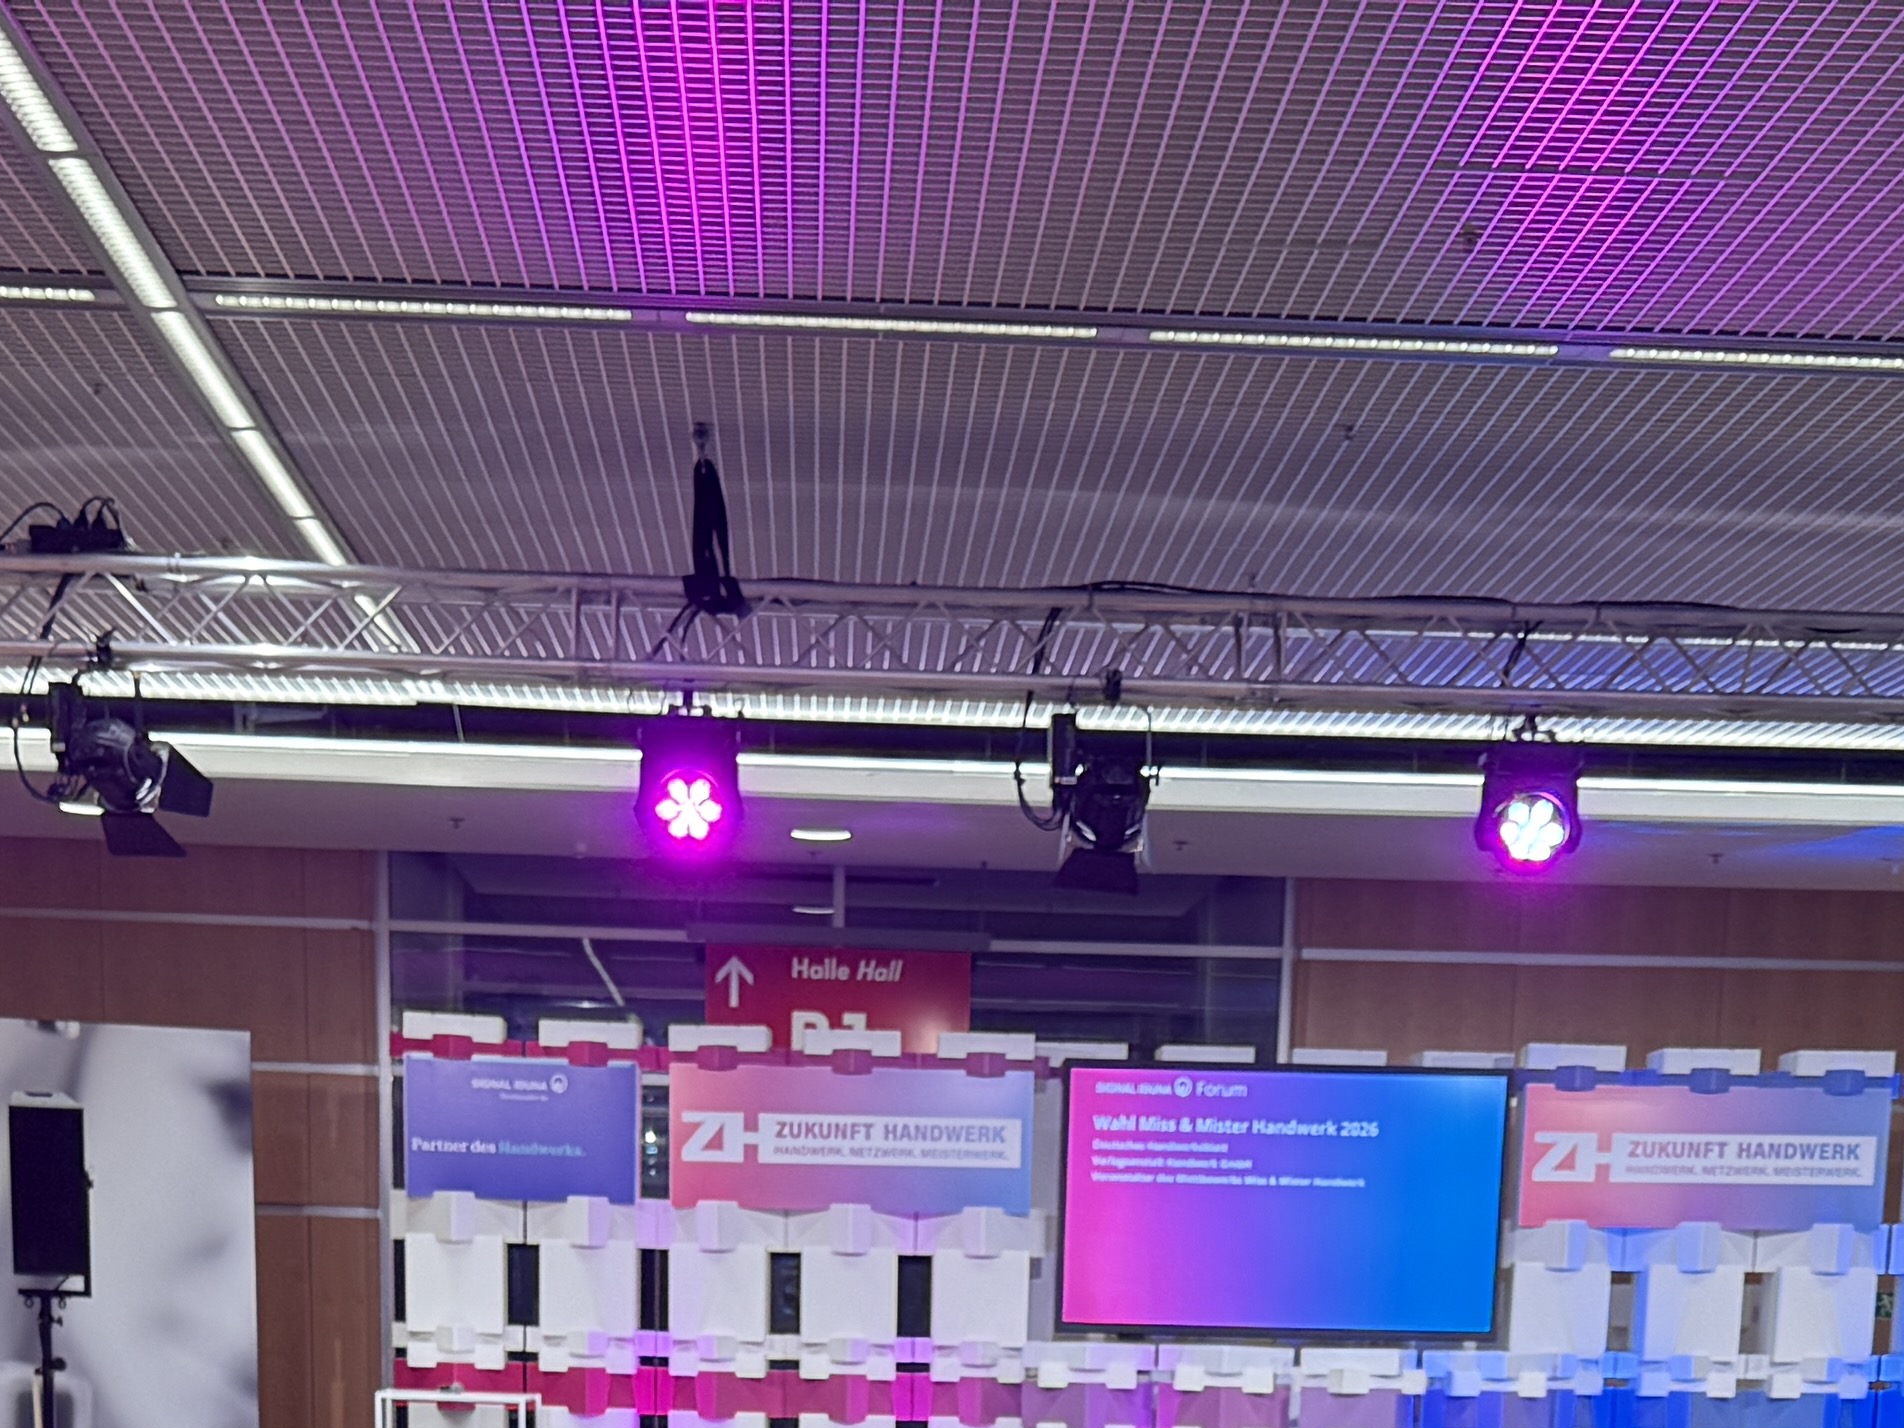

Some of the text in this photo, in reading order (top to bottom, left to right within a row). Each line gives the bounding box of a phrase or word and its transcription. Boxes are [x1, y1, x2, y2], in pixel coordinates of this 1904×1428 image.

[791, 957, 904, 982] Halle Hall
[1196, 1081, 1248, 1097] Forum
[775, 1121, 1007, 1143] ZUKUNFT HANDWERK
[1093, 1115, 1380, 1138] Wahl Miss & Mister Handwerk 2026
[411, 1137, 469, 1153] Partner
[470, 1139, 496, 1154] des
[1628, 1141, 1860, 1160] ZUKUNFT HANDWERK
